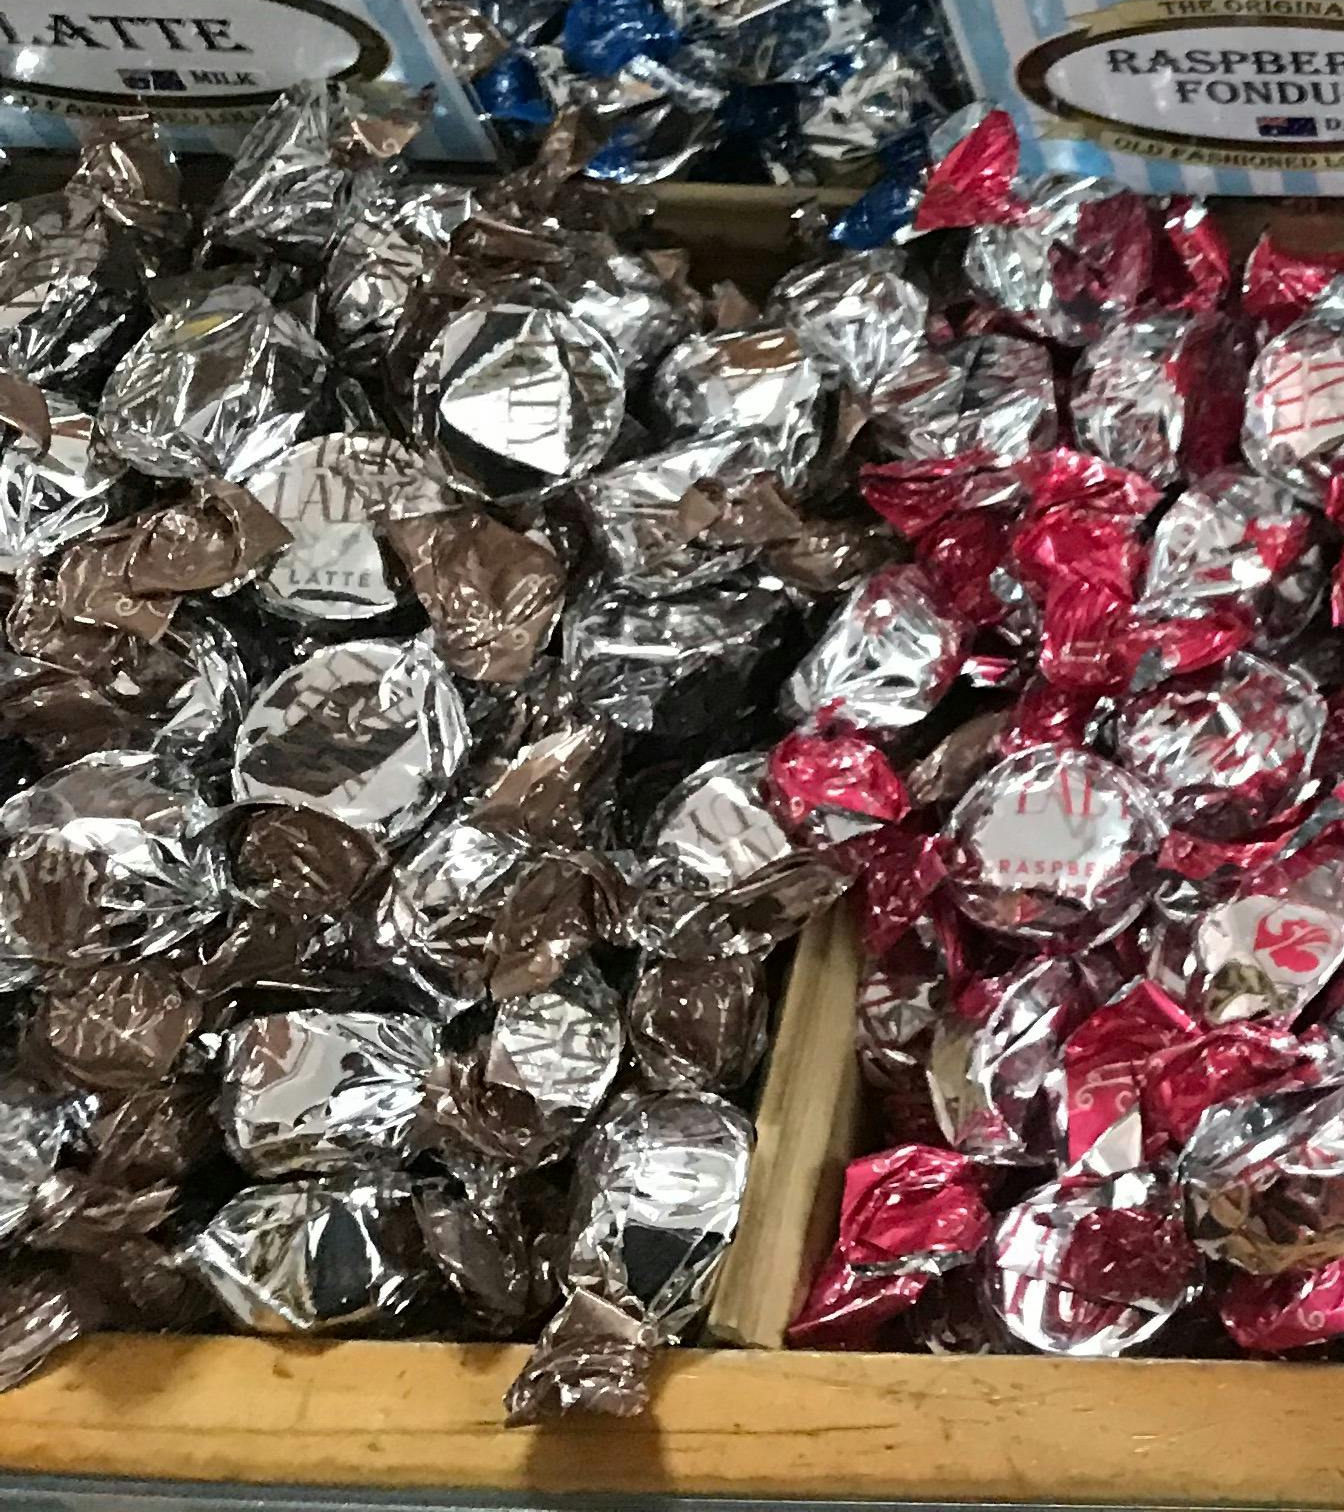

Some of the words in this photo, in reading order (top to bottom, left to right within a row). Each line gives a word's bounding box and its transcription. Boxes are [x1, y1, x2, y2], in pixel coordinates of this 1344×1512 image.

[1159, 0, 1221, 16] THE
[0, 11, 254, 54] LATTE
[189, 69, 259, 86] MILK
[1114, 137, 1161, 157] OLD
[1169, 144, 1318, 169] FASHIONED
[288, 569, 371, 588] LATTE
